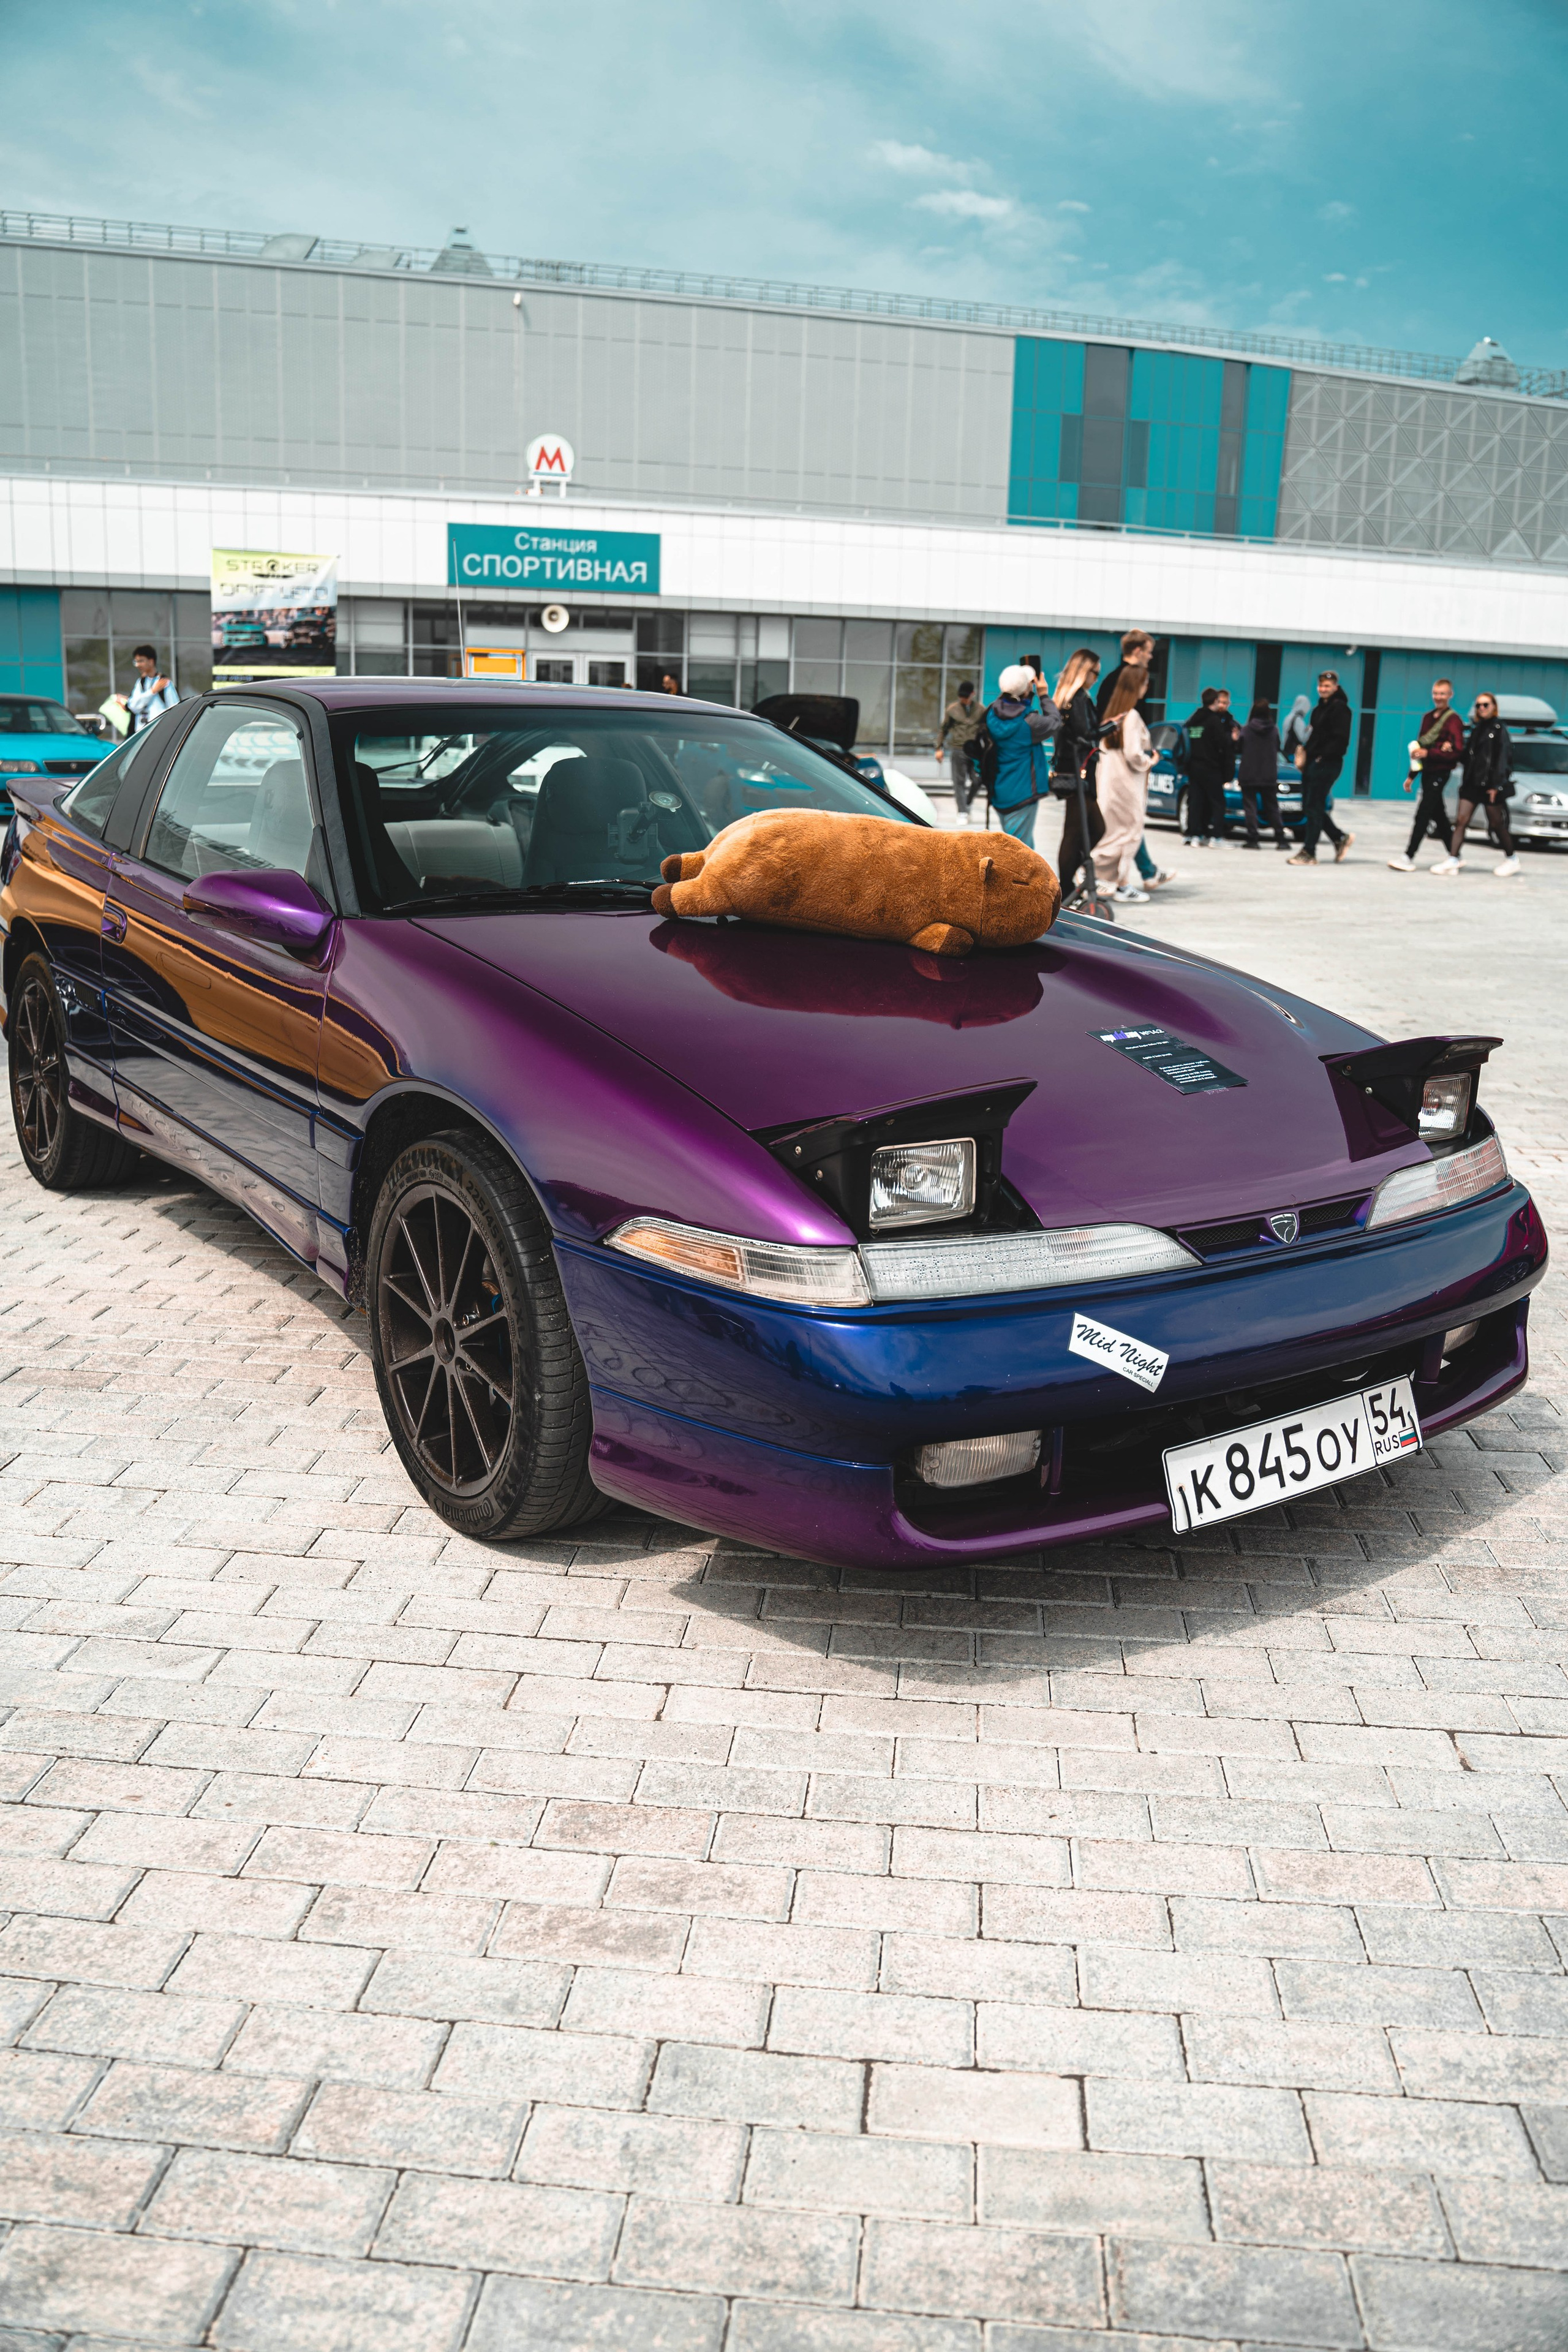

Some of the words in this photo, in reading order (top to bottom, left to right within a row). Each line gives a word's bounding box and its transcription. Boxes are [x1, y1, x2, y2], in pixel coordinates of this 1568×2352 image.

[514, 532, 598, 554] Станция
[226, 558, 319, 575] STROKER
[462, 553, 647, 584] СПОРТИВНАЯ
[1077, 1324, 1117, 1352] Mid
[1120, 1343, 1164, 1376] Night
[1122, 1366, 1133, 1376] CAR
[1368, 1387, 1406, 1436] 54
[1374, 1434, 1400, 1456] RUS
[442, 1496, 495, 1526] Continental
